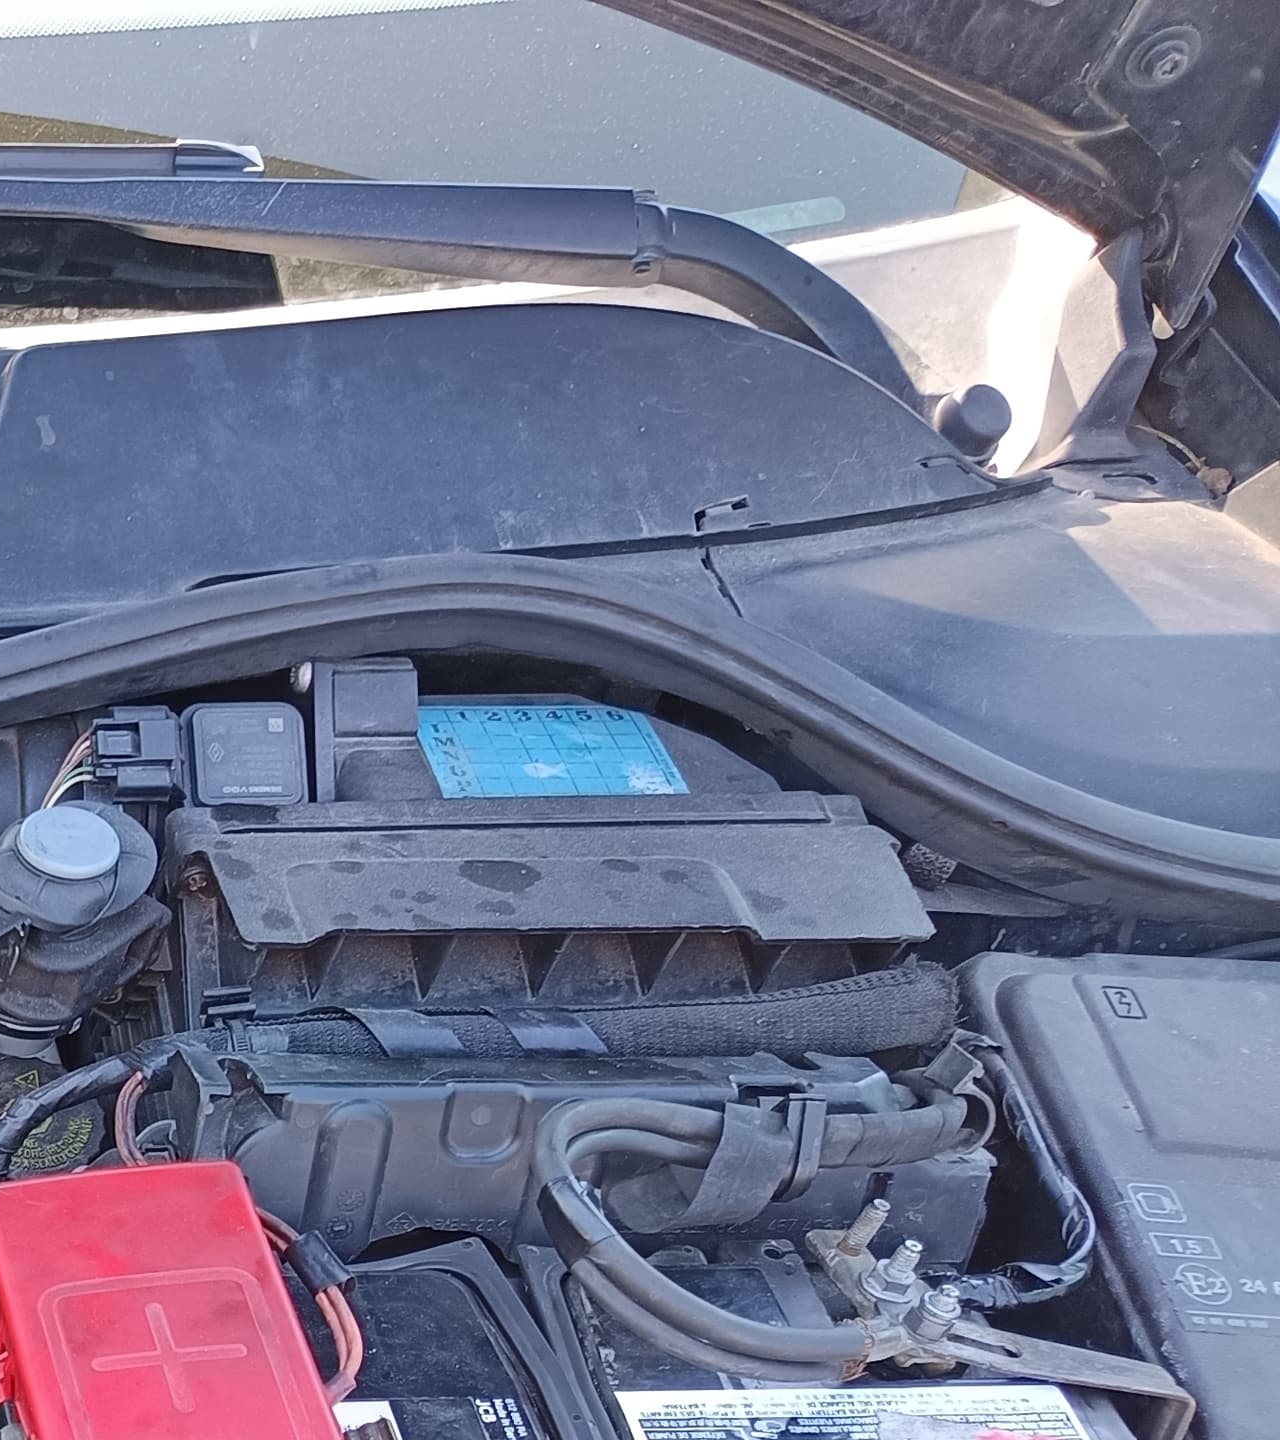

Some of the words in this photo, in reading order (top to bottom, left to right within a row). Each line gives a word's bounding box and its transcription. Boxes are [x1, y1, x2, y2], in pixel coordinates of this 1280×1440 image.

[483, 711, 503, 722] 2
[513, 711, 532, 722] 3
[543, 710, 563, 721] 4
[574, 710, 594, 721] 5
[605, 710, 624, 721] 6
[475, 1398, 497, 1423] JCB
